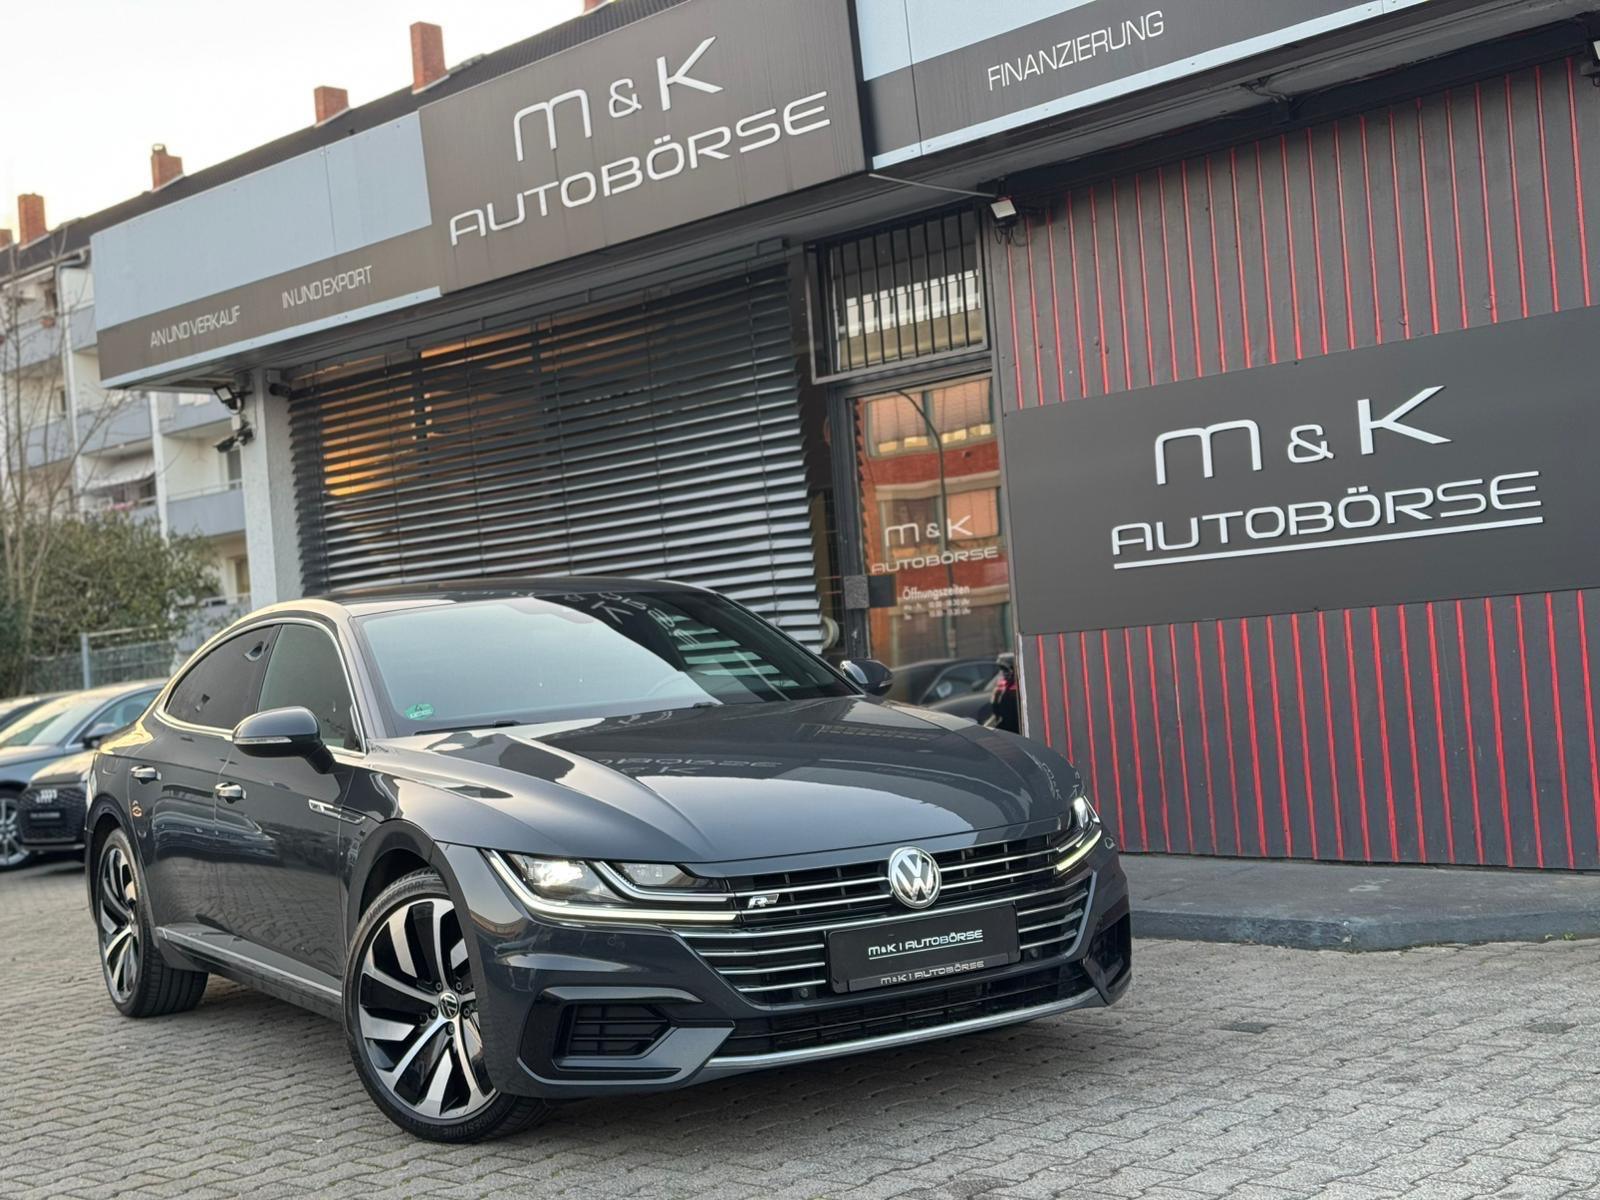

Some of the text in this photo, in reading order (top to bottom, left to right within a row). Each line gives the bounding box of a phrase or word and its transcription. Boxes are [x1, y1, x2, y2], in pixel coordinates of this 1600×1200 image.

[987, 10, 1164, 91] FINANZIERUNG
[513, 35, 724, 162] M & K
[449, 90, 831, 246] AUTOBÖRSE
[281, 265, 373, 309] IN UND EXPORT
[150, 304, 241, 348] AN UND VERKAUF
[1154, 385, 1452, 485] M & K
[925, 523, 941, 538] &
[946, 514, 974, 540] K
[1111, 470, 1542, 556] AUTOBÖRSE
[871, 546, 999, 574] AUTOBÖRSE
[903, 585, 971, 600] Öffnungszeiten
[905, 929, 984, 950] AUTOBÖRSE
[914, 961, 985, 979] AUTOBÖRSE
